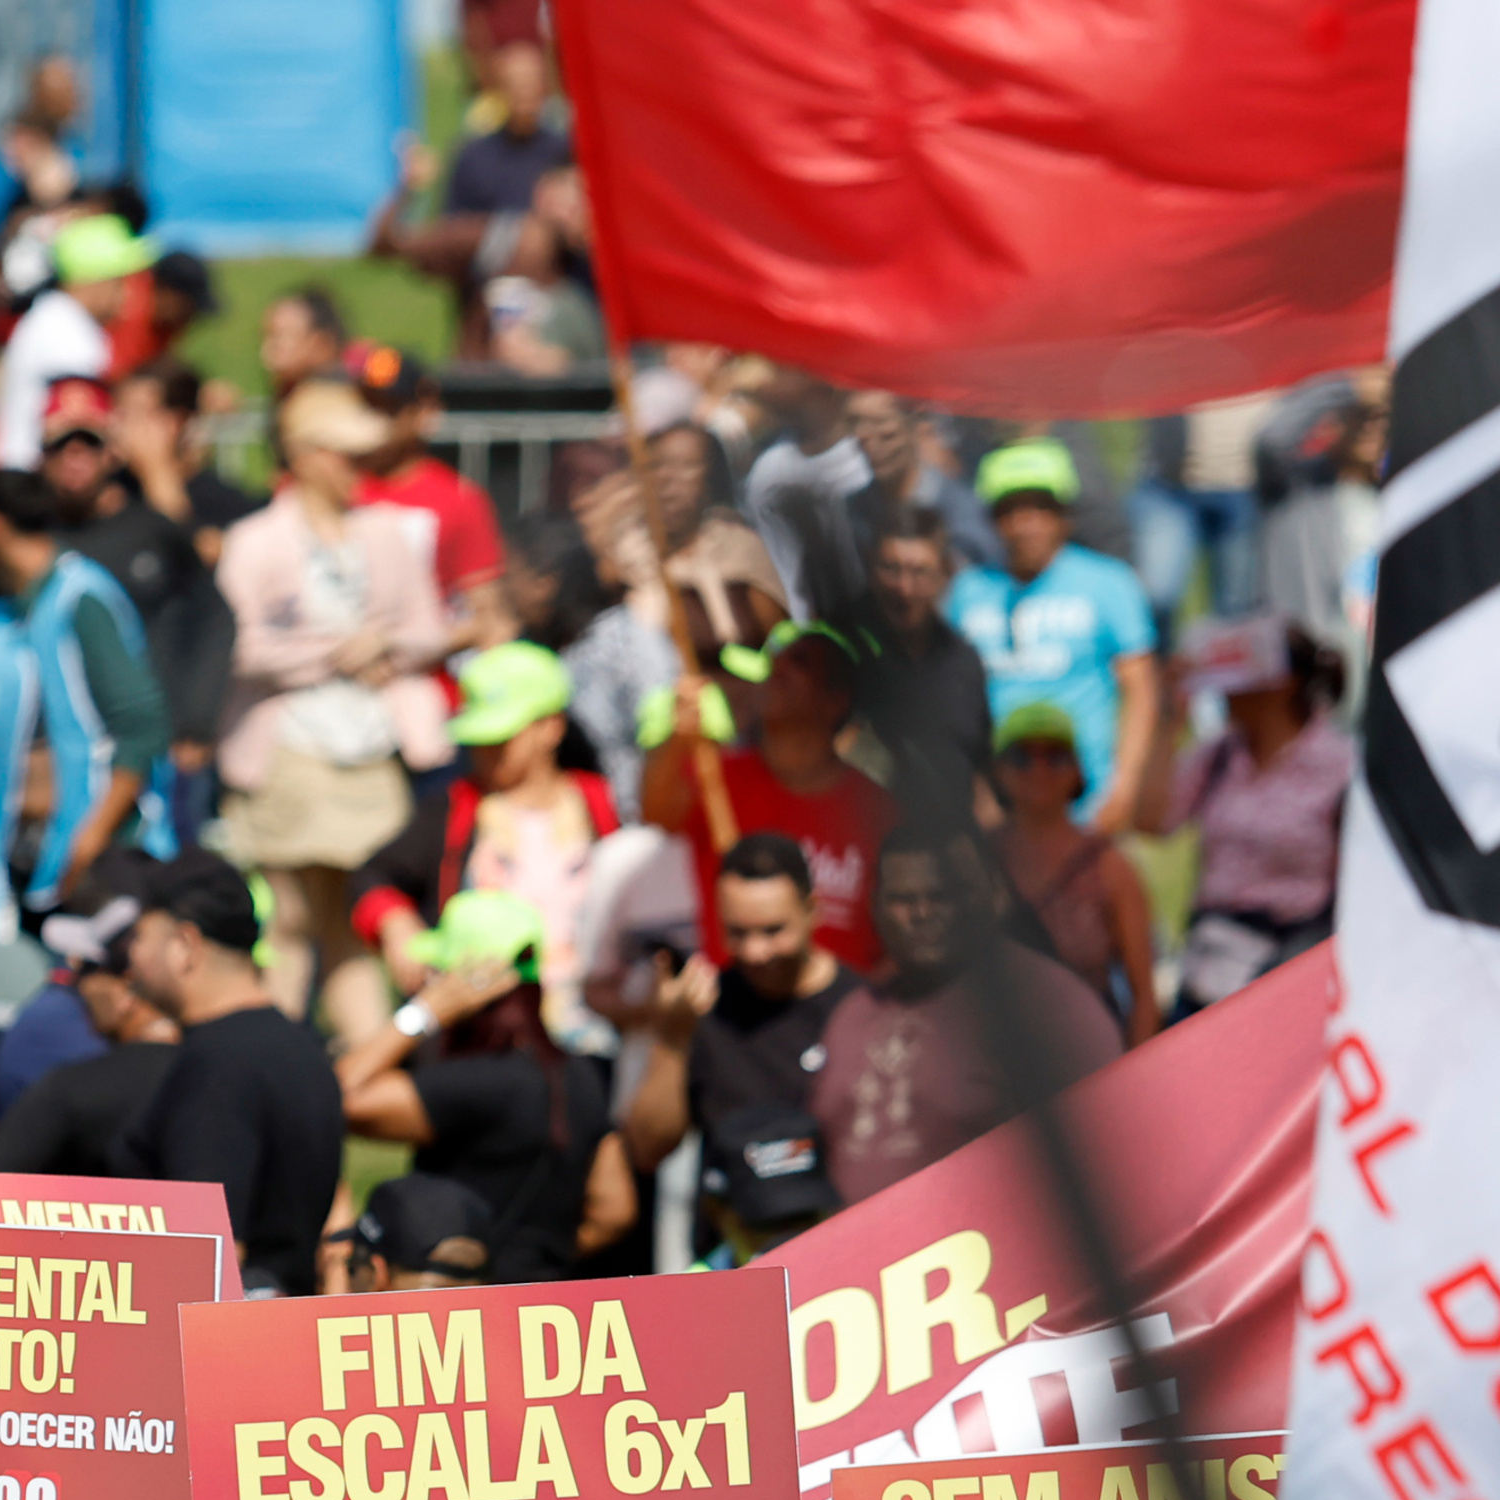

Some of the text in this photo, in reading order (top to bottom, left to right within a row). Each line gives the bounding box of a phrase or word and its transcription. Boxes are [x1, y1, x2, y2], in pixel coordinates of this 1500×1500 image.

[316, 1299, 647, 1411] FIM DA
[105, 1411, 175, 1454] NÃO!
[603, 1391, 752, 1496] 6x1
